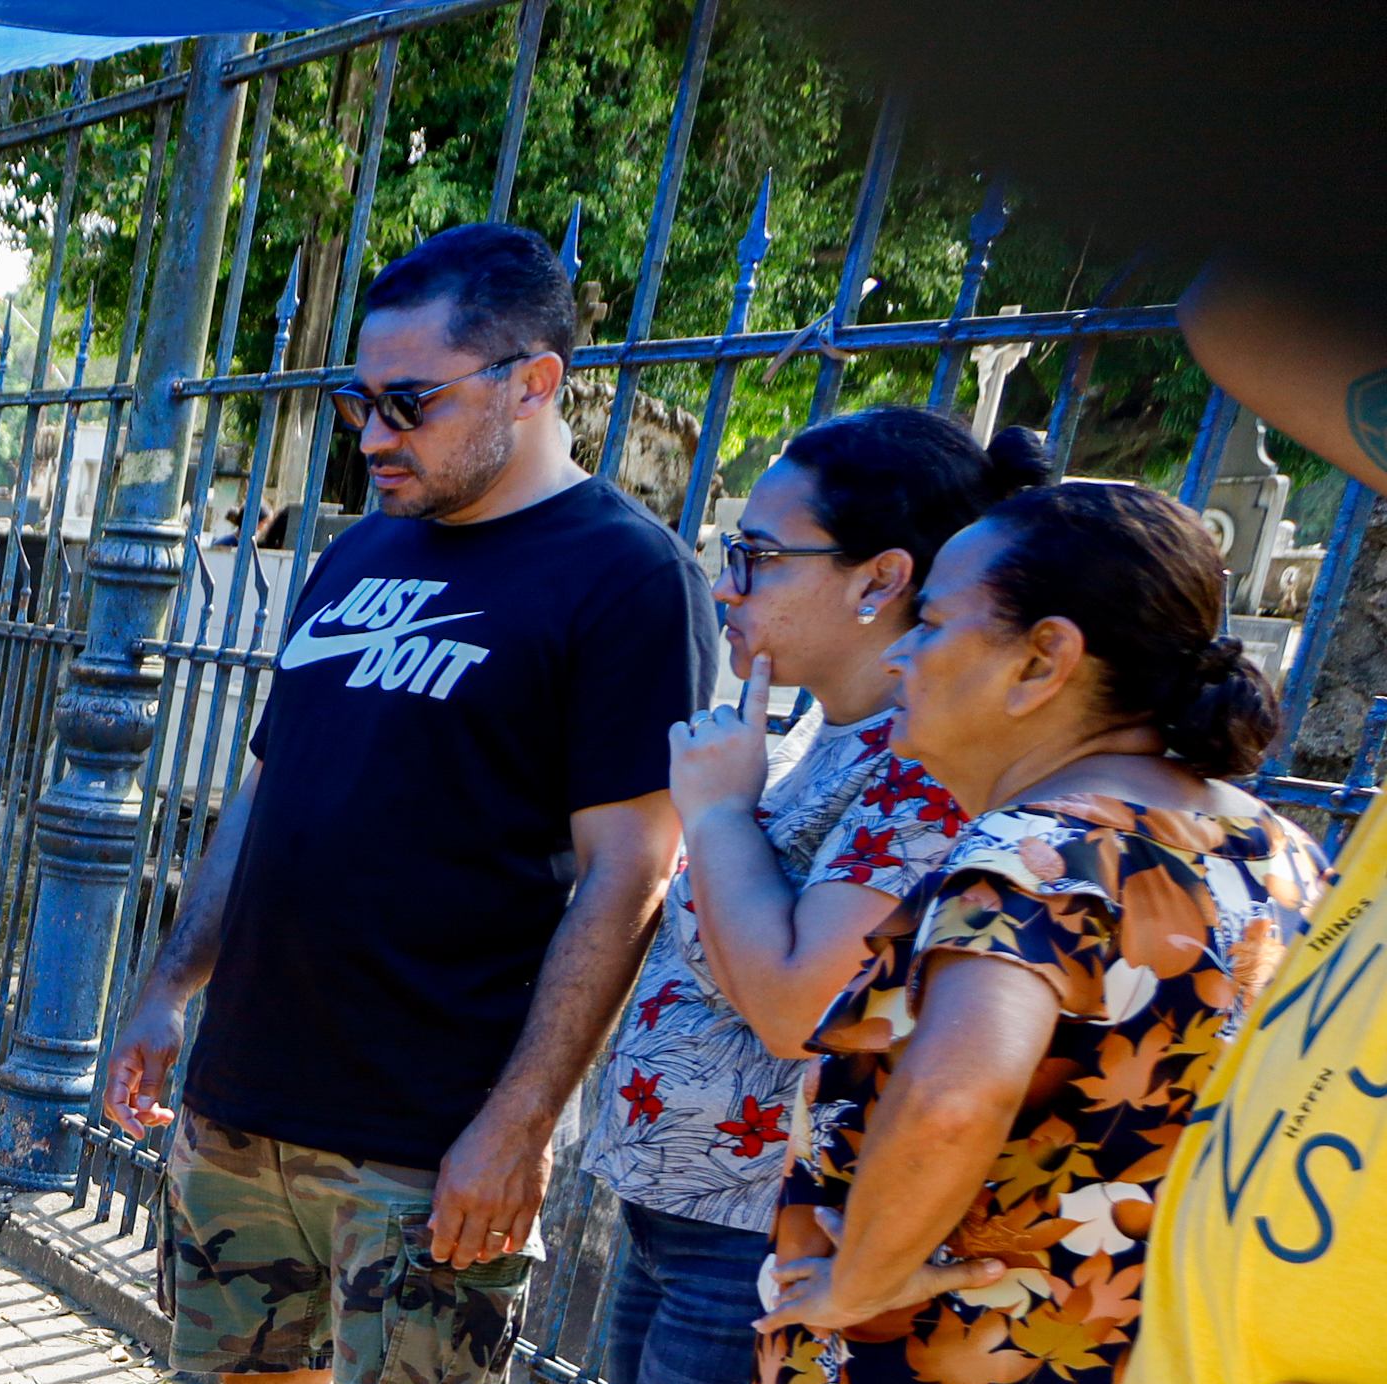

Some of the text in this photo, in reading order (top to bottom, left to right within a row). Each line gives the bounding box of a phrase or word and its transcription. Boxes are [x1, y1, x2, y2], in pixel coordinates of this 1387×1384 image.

[318, 577, 449, 630] JUST
[1309, 898, 1371, 952] THINGS
[1284, 1068, 1334, 1139] HAPPEN
